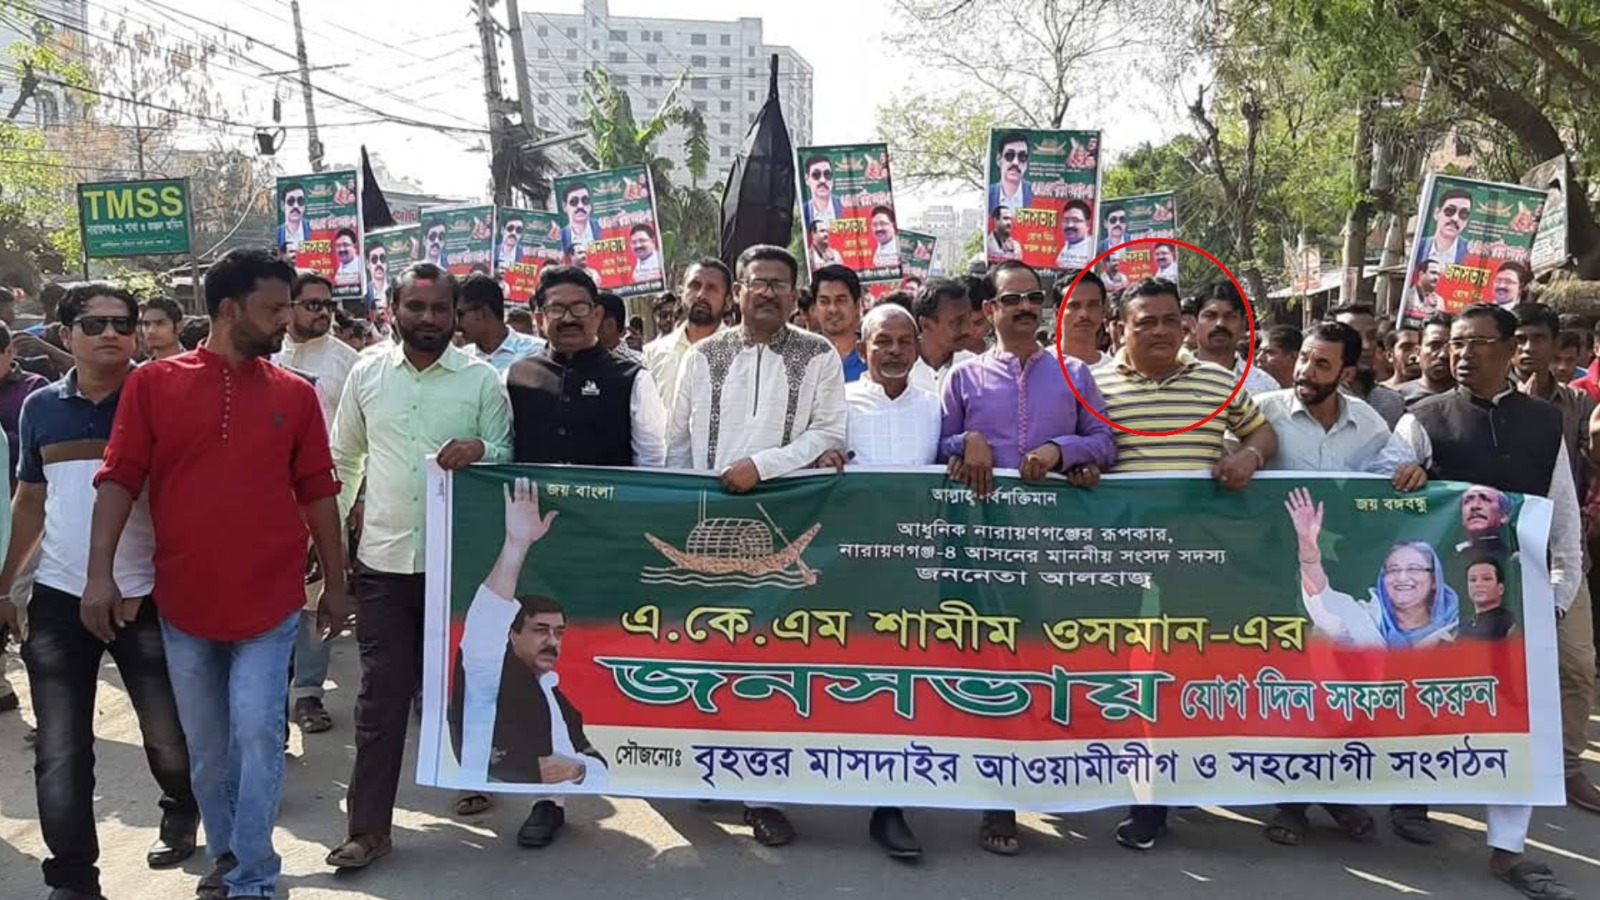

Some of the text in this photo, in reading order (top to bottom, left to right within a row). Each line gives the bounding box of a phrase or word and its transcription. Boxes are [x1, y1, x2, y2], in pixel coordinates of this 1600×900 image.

[83, 187, 184, 220] TMSS
[547, 483, 615, 501] জয় বাংলা
[1354, 497, 1428, 513] জয় বঙ্গবন্ধু
[896, 518, 1174, 544] আধুনিক নারায়ণগঞ্জের রূপকার,
[838, 543, 1227, 565] নারায়ণগঞ্জ-৪ আসনের মাননীয় সংসদ সদস্য
[915, 567, 1029, 585] জননেতা
[621, 600, 1308, 653] এ.কে.এম শামীম ওসমান-এর
[594, 655, 1499, 726] জনসভায় যোগ দিন সফল করুন
[691, 744, 793, 787] বৃহত্তর
[804, 741, 960, 787] মাসদাইর
[973, 741, 1179, 787] আওয়ামীলীগ
[1193, 754, 1217, 779] ও
[1228, 741, 1376, 784] সহযোগী
[1387, 735, 1508, 781] সংগঠন
